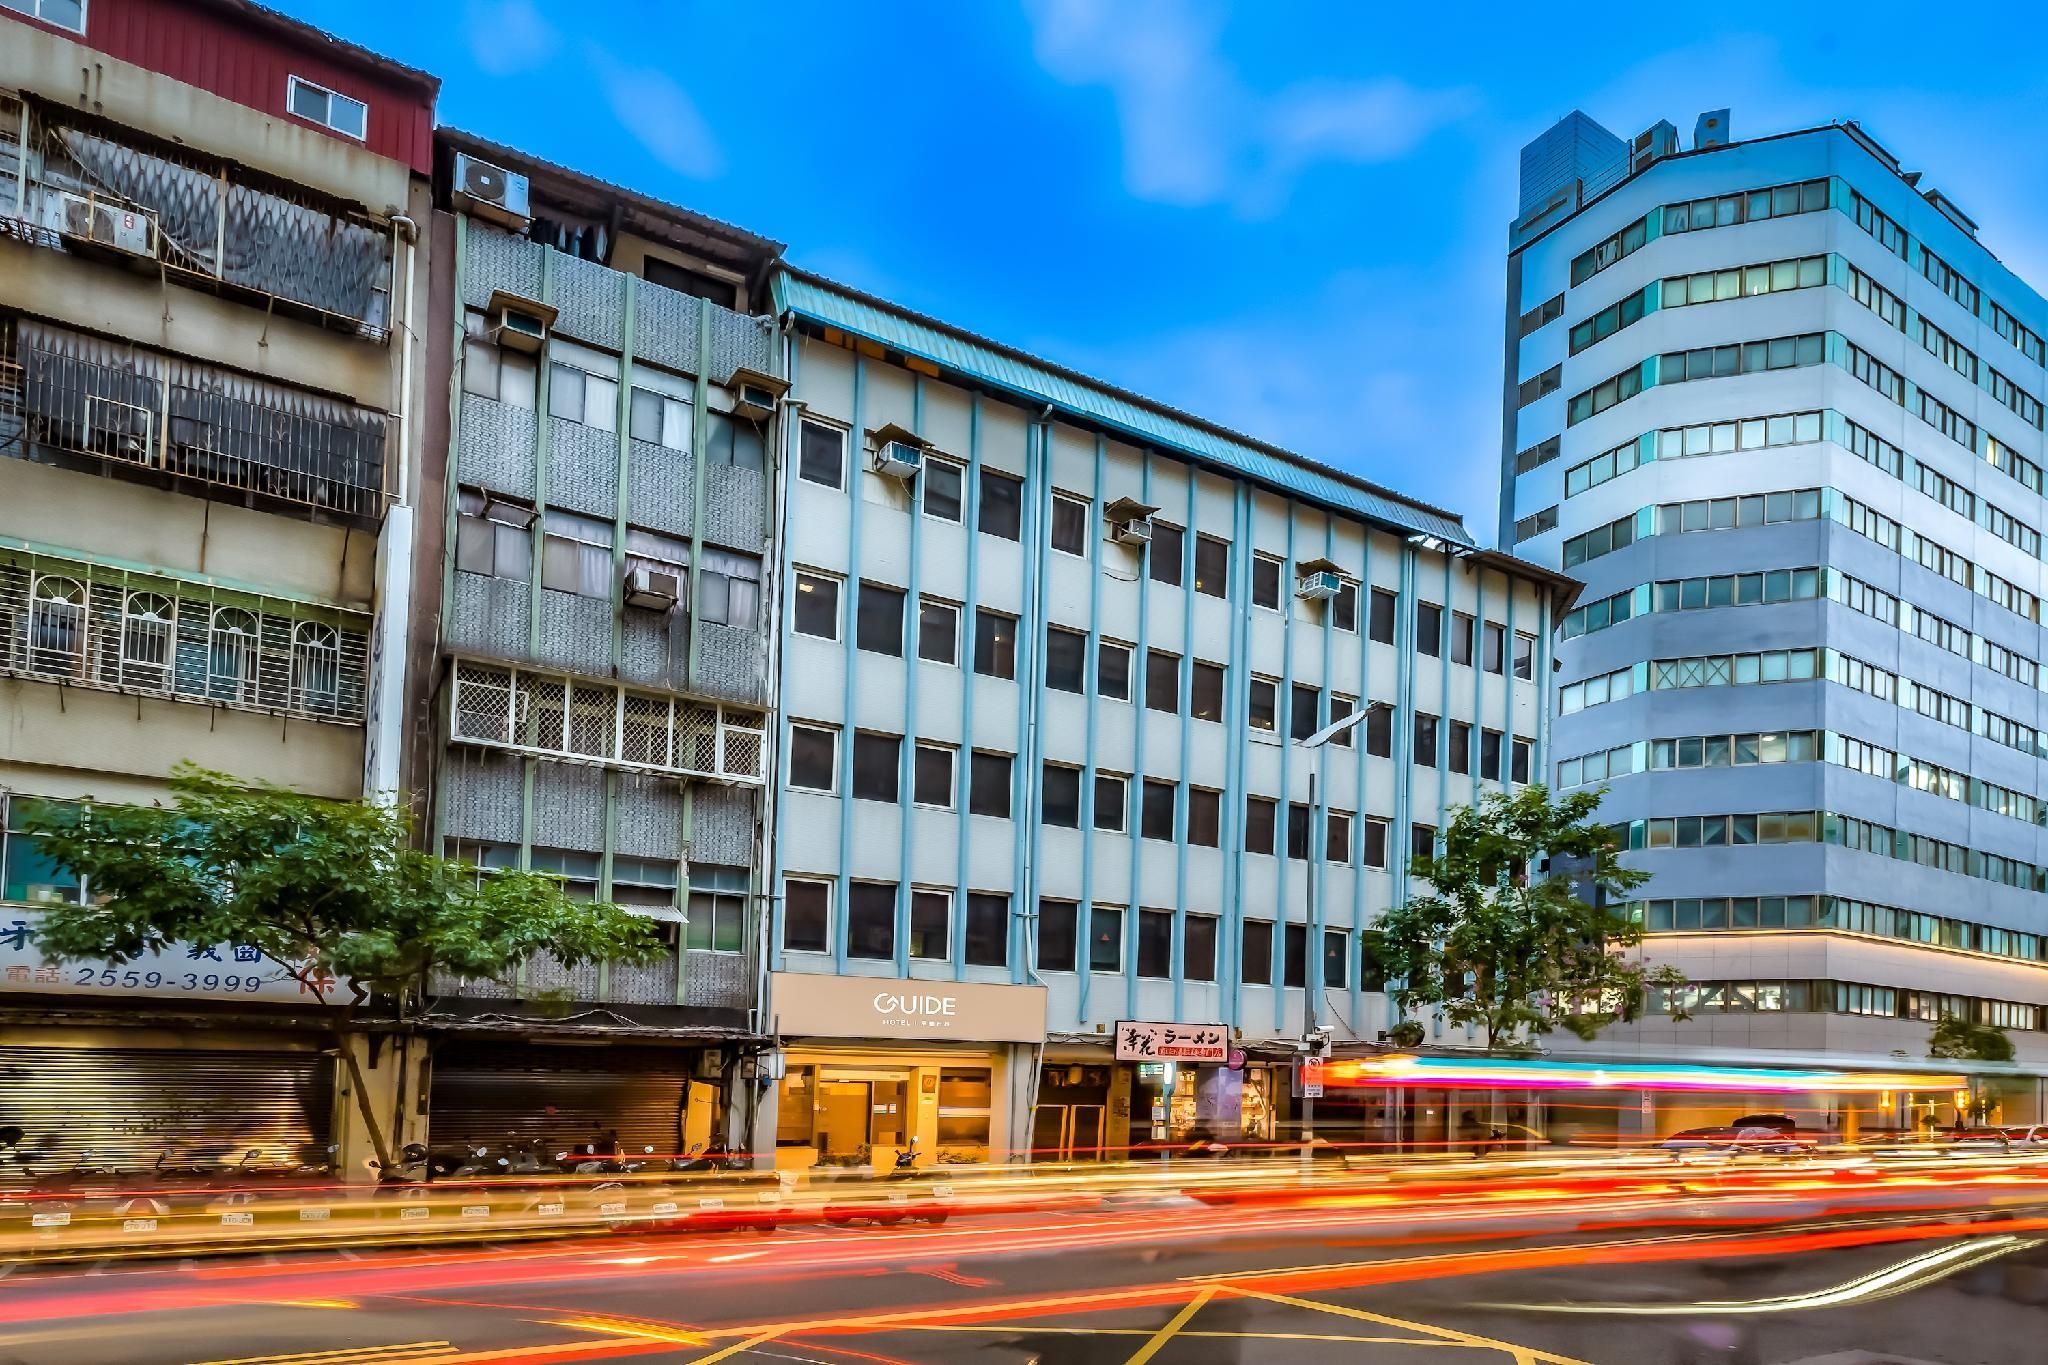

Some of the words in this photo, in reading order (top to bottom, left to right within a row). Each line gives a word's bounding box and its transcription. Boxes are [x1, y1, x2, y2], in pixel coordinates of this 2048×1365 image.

[74, 967, 262, 993] 2559-3999
[873, 992, 957, 1016] GUIDE
[882, 1019, 911, 1027] HOTEL
[1164, 1029, 1220, 1045] ラーメン
